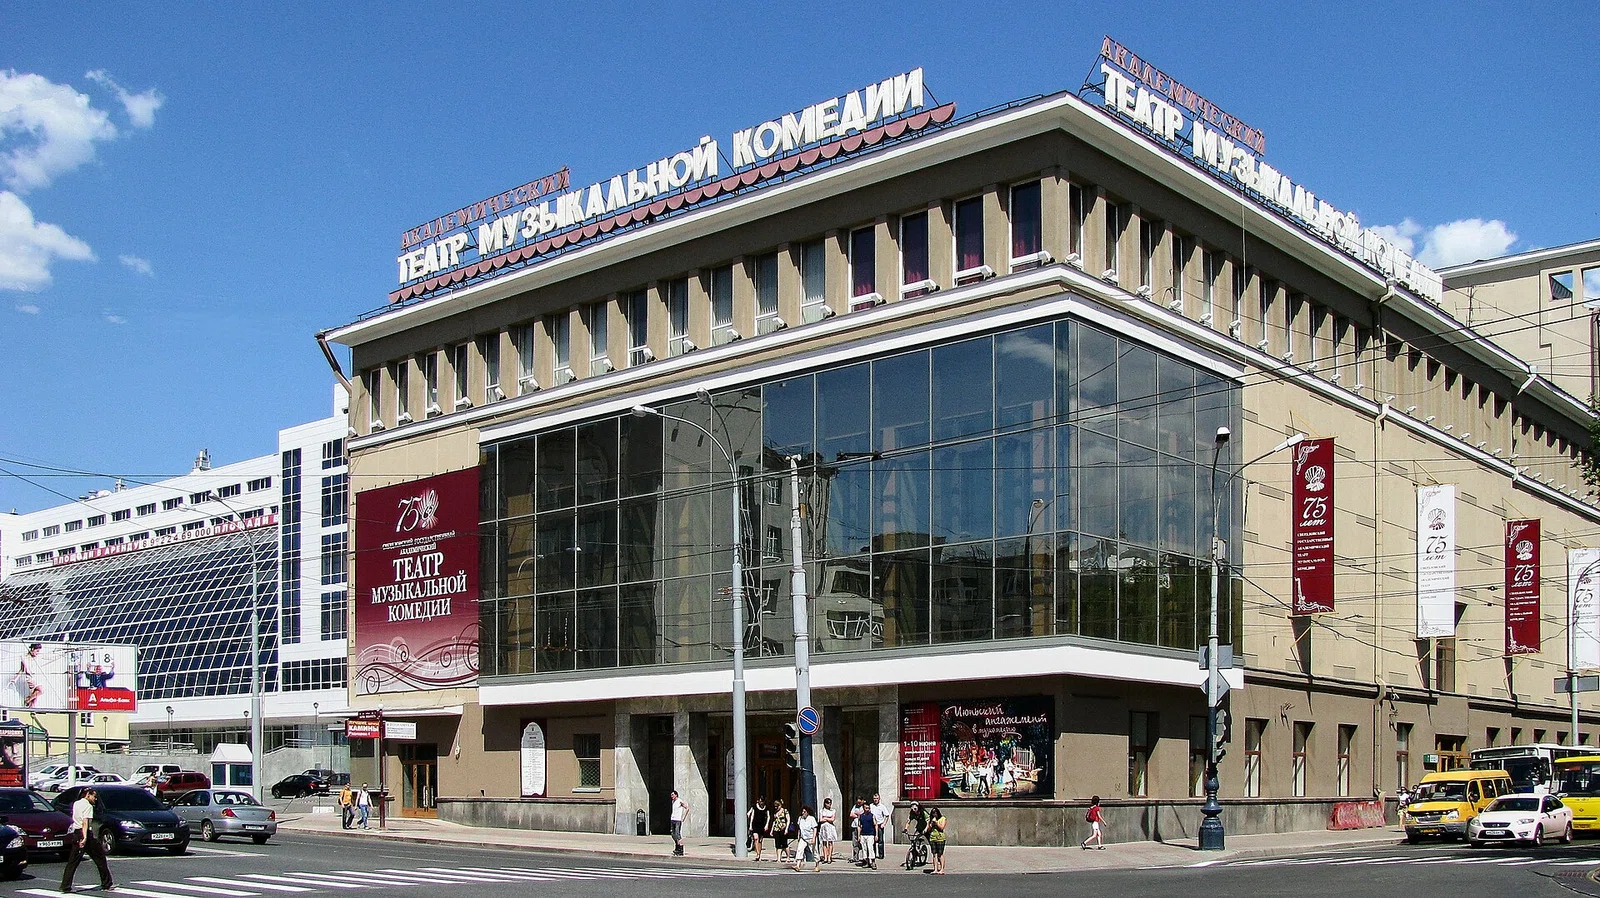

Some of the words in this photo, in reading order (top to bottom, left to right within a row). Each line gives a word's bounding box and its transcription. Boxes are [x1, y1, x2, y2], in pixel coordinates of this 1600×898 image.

[1101, 36, 1265, 156] АКАДЕМИЧЕСКИЙ
[1101, 62, 1184, 142] ТЕАТР
[1193, 120, 1360, 256] МУЗЫКАЛЬНОЙ
[397, 231, 468, 284] ТЕАТР
[478, 134, 718, 256] МУЗЫКАЛЬНОЙ
[732, 66, 924, 168] КОМЕДИИ
[401, 165, 571, 249] АКАДЕМИЧЕСКИЙ
[396, 495, 423, 532] 75
[1303, 496, 1329, 519] 75
[1299, 518, 1327, 527] лет
[53, 550, 94, 566] ПЛОЩАДИ
[104, 541, 140, 556] АРЕНДУ
[215, 516, 269, 535] ПЛОЩАДИ
[1426, 535, 1448, 554] 75
[393, 552, 444, 582] ТЕАТР
[1514, 563, 1536, 581] 75
[371, 570, 468, 604] МУЗЫКАЛЬНОЙ
[1575, 587, 1595, 603] 75
[388, 598, 452, 622] КОМЕДИИ
[944, 703, 1005, 718] Июньский
[985, 713, 1048, 726] ангажемент
